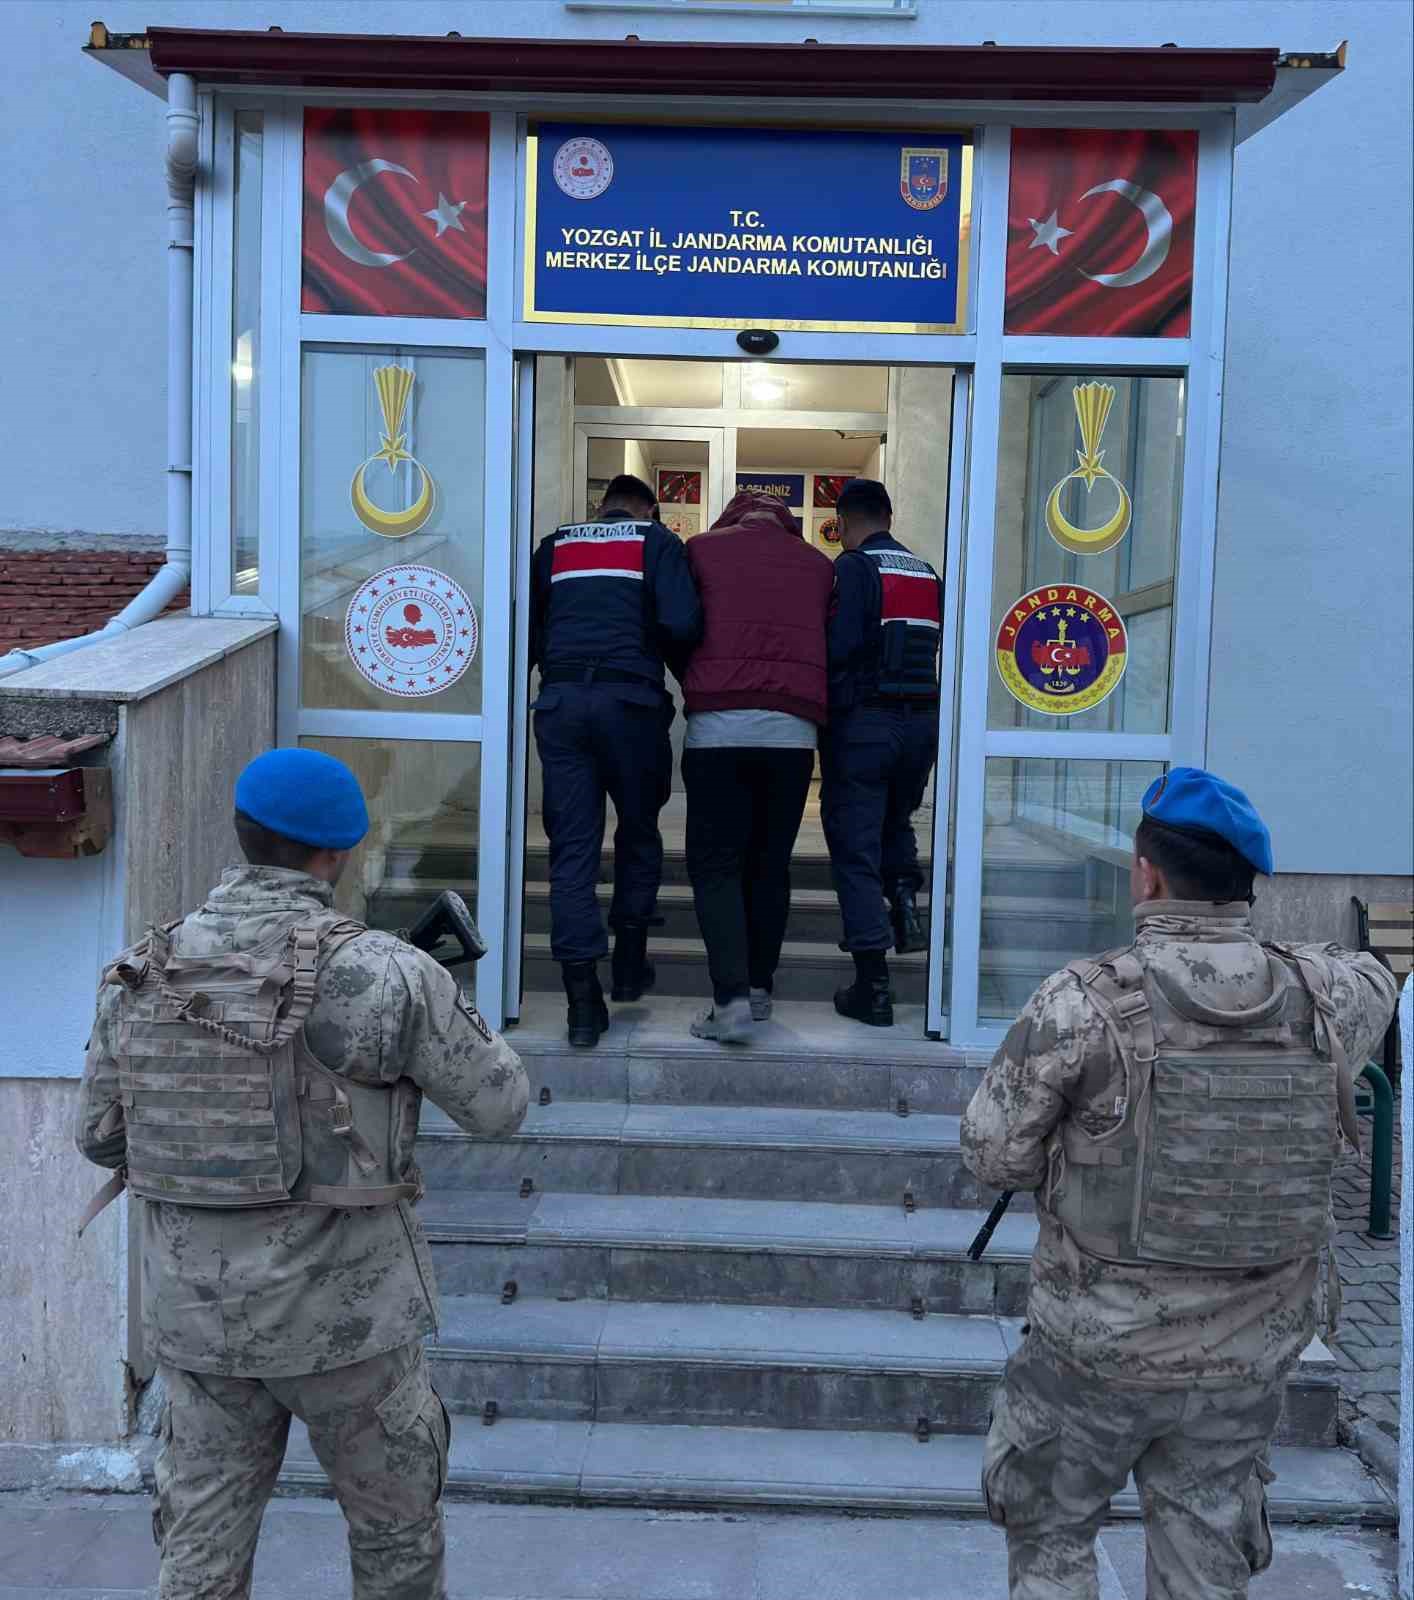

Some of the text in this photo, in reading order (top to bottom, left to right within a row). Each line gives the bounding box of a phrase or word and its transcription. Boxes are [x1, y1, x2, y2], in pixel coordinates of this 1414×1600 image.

[729, 211, 766, 229] T.C.
[561, 228, 933, 256] YOZGAT İL JANDARMA KOMUTANLIĞI
[545, 251, 947, 279] MERKEZ İLÇE JANDARMA KOMUTANLIĞI
[1005, 589, 1121, 639] JANDARMA
